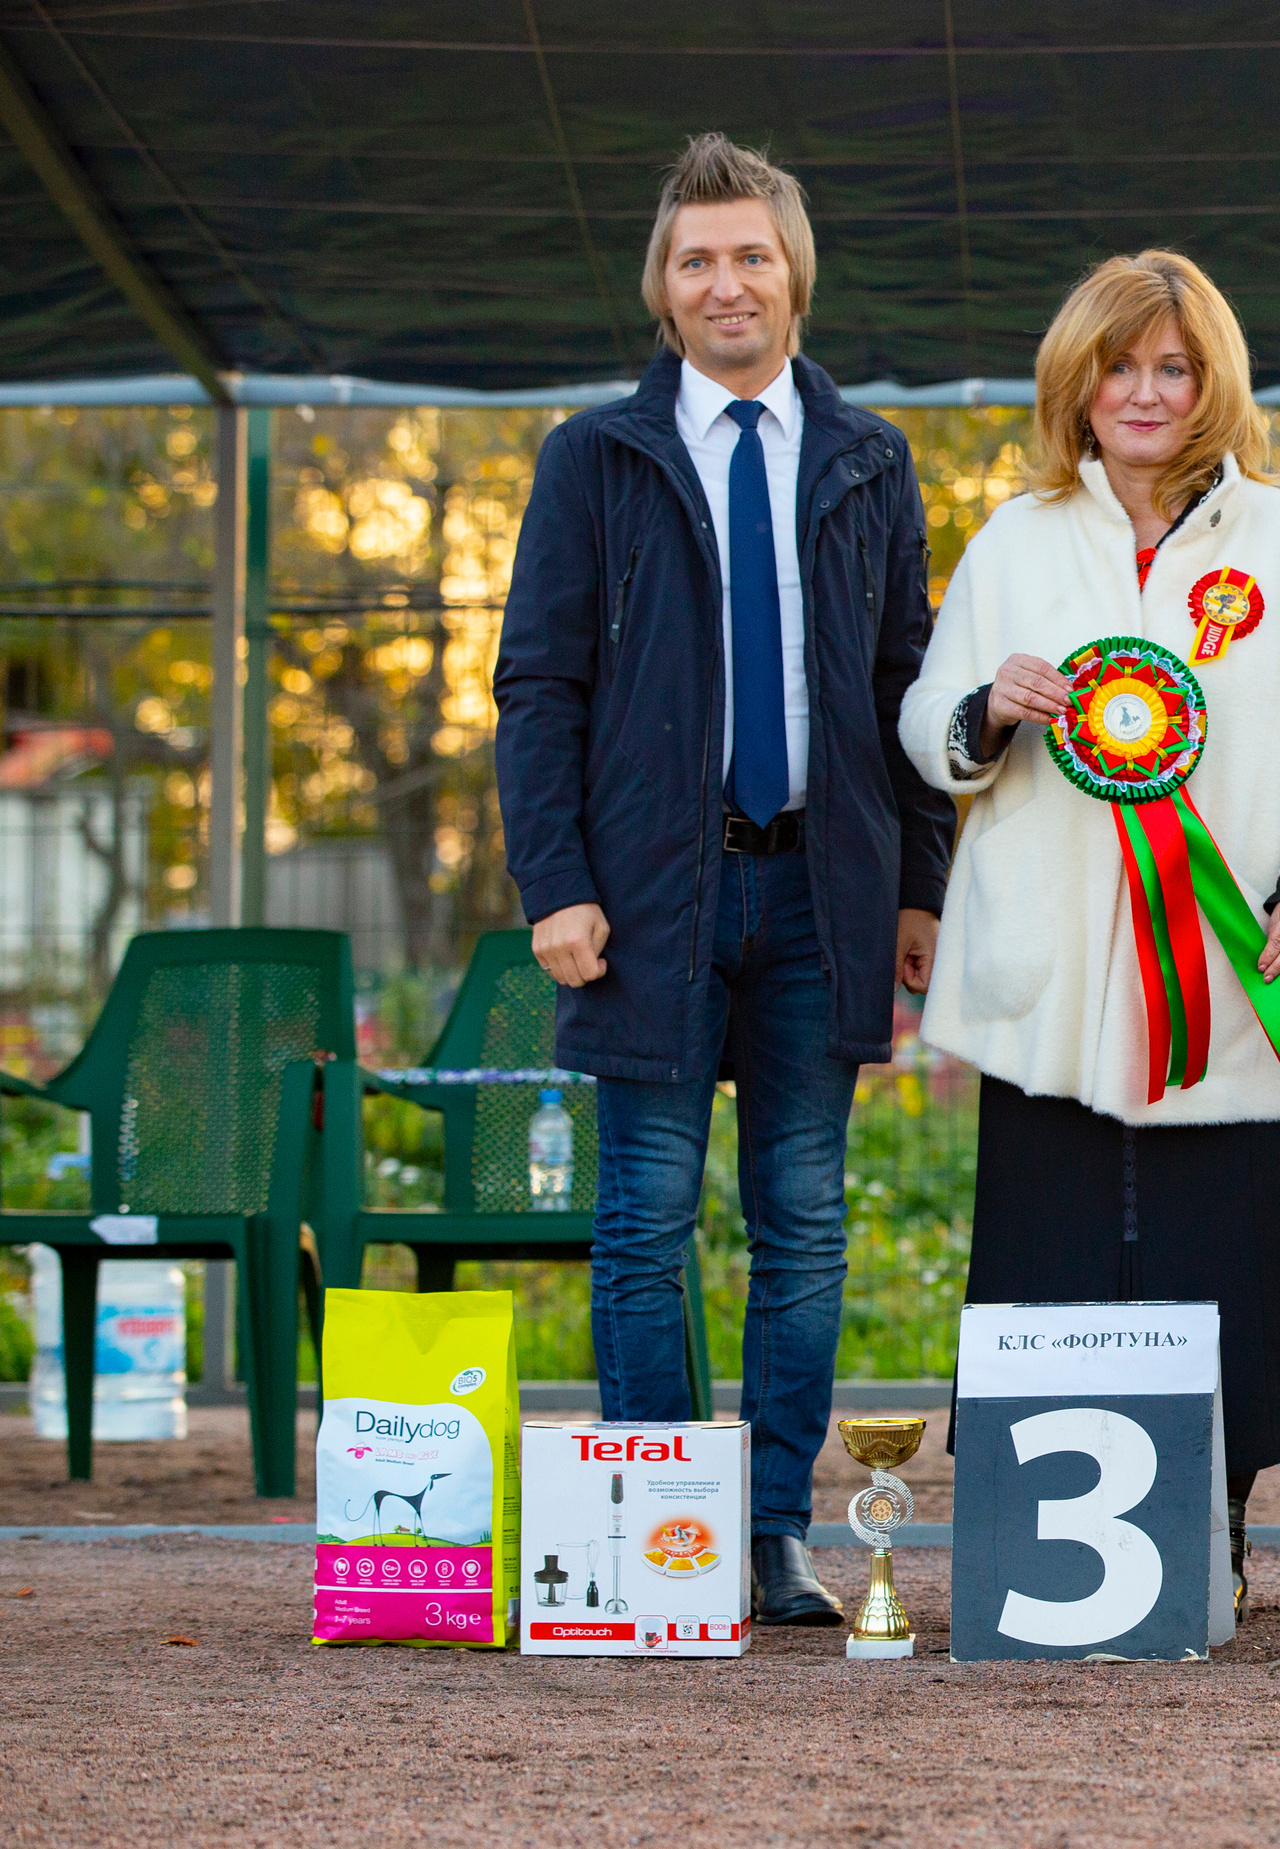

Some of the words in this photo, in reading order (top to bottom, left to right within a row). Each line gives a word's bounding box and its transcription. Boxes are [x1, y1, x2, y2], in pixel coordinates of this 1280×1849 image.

[1201, 623, 1223, 656] JUDGE
[997, 1334, 1046, 1351] КЛС
[1051, 1331, 1188, 1350] «ФОРТУНА»
[374, 1447, 404, 1460] LAMB
[571, 1435, 692, 1462] Tefal
[997, 1407, 1164, 1647] 3
[348, 1617, 371, 1625] years
[425, 1602, 442, 1626] 3
[552, 1626, 613, 1637] Optitouch
